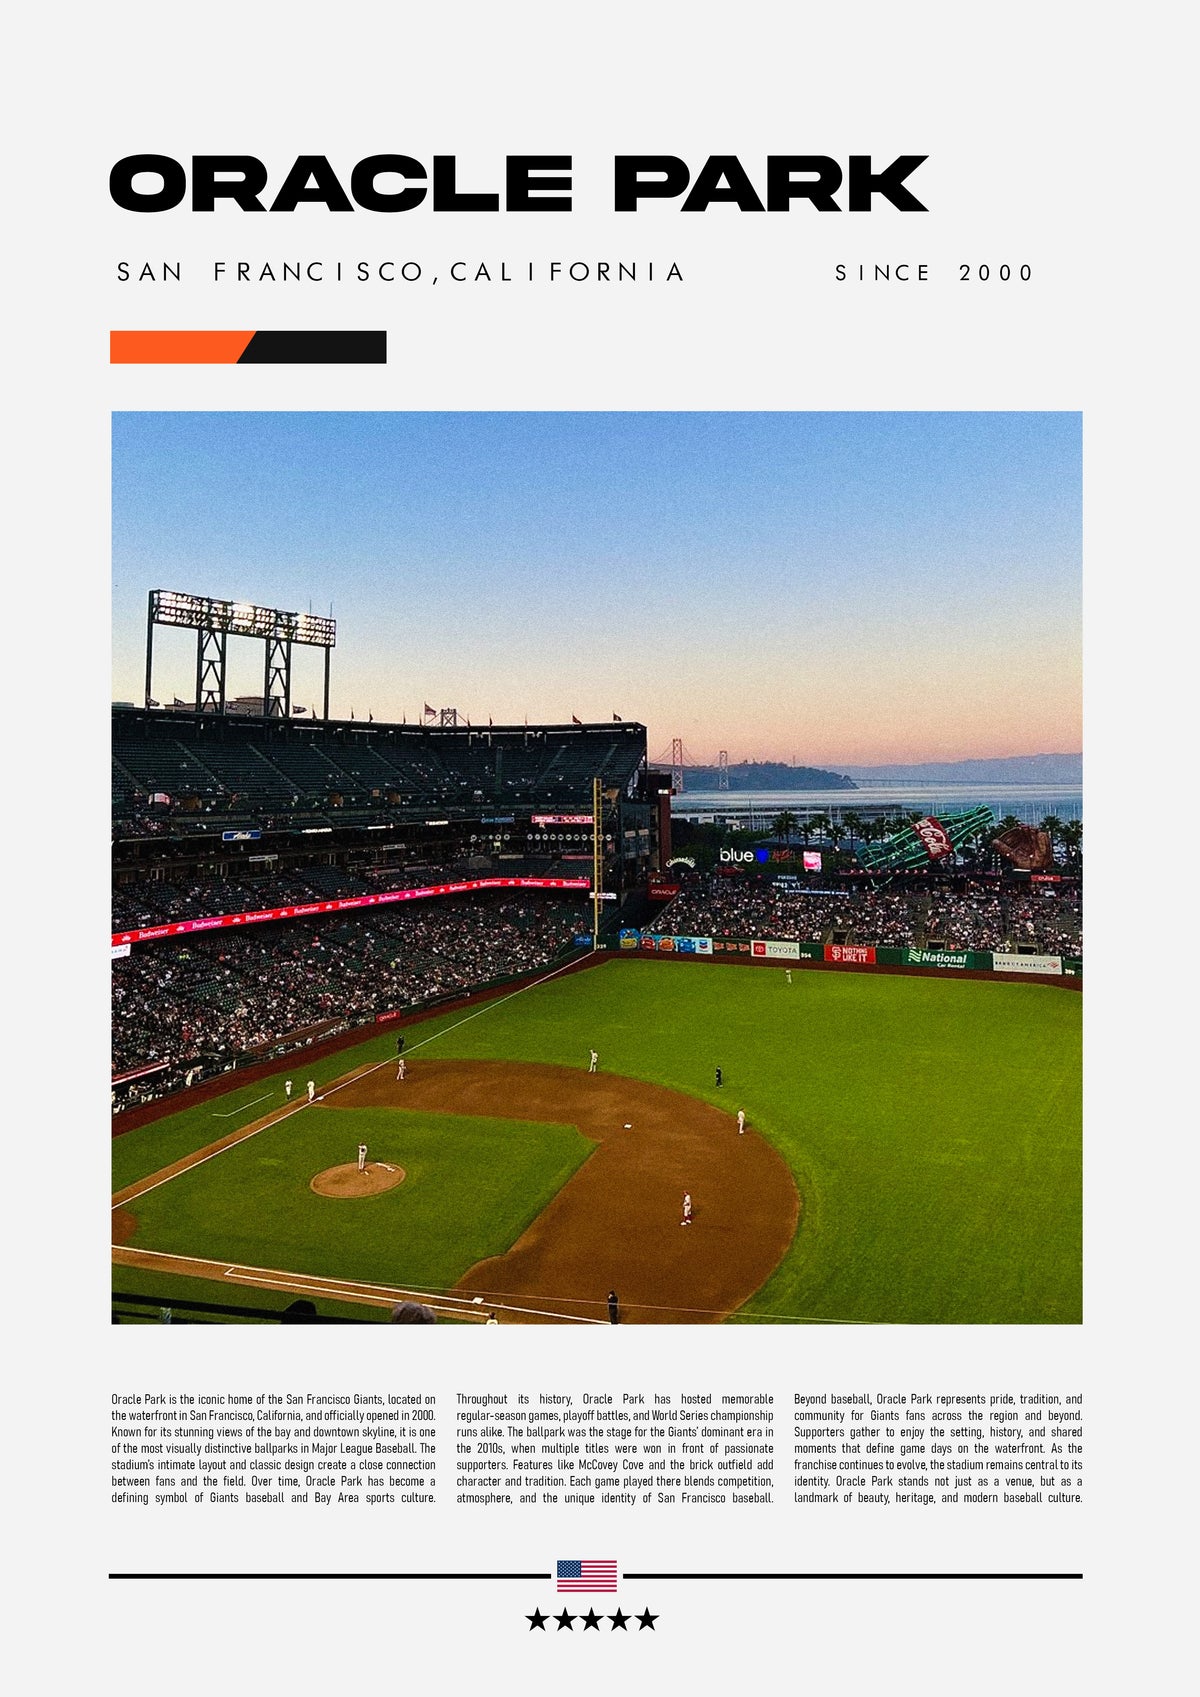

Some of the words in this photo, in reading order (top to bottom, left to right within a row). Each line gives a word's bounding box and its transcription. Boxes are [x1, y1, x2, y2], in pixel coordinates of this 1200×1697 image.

[720, 847, 754, 863] blue
[138, 928, 169, 940] Budweiser
[192, 919, 223, 930] Budweiser
[246, 912, 274, 922] Budweiser
[294, 905, 320, 915] Budweiser
[768, 946, 797, 954] TOYOTA
[842, 954, 857, 962] LIKE
[858, 954, 868, 962] IT
[922, 952, 967, 964] National
